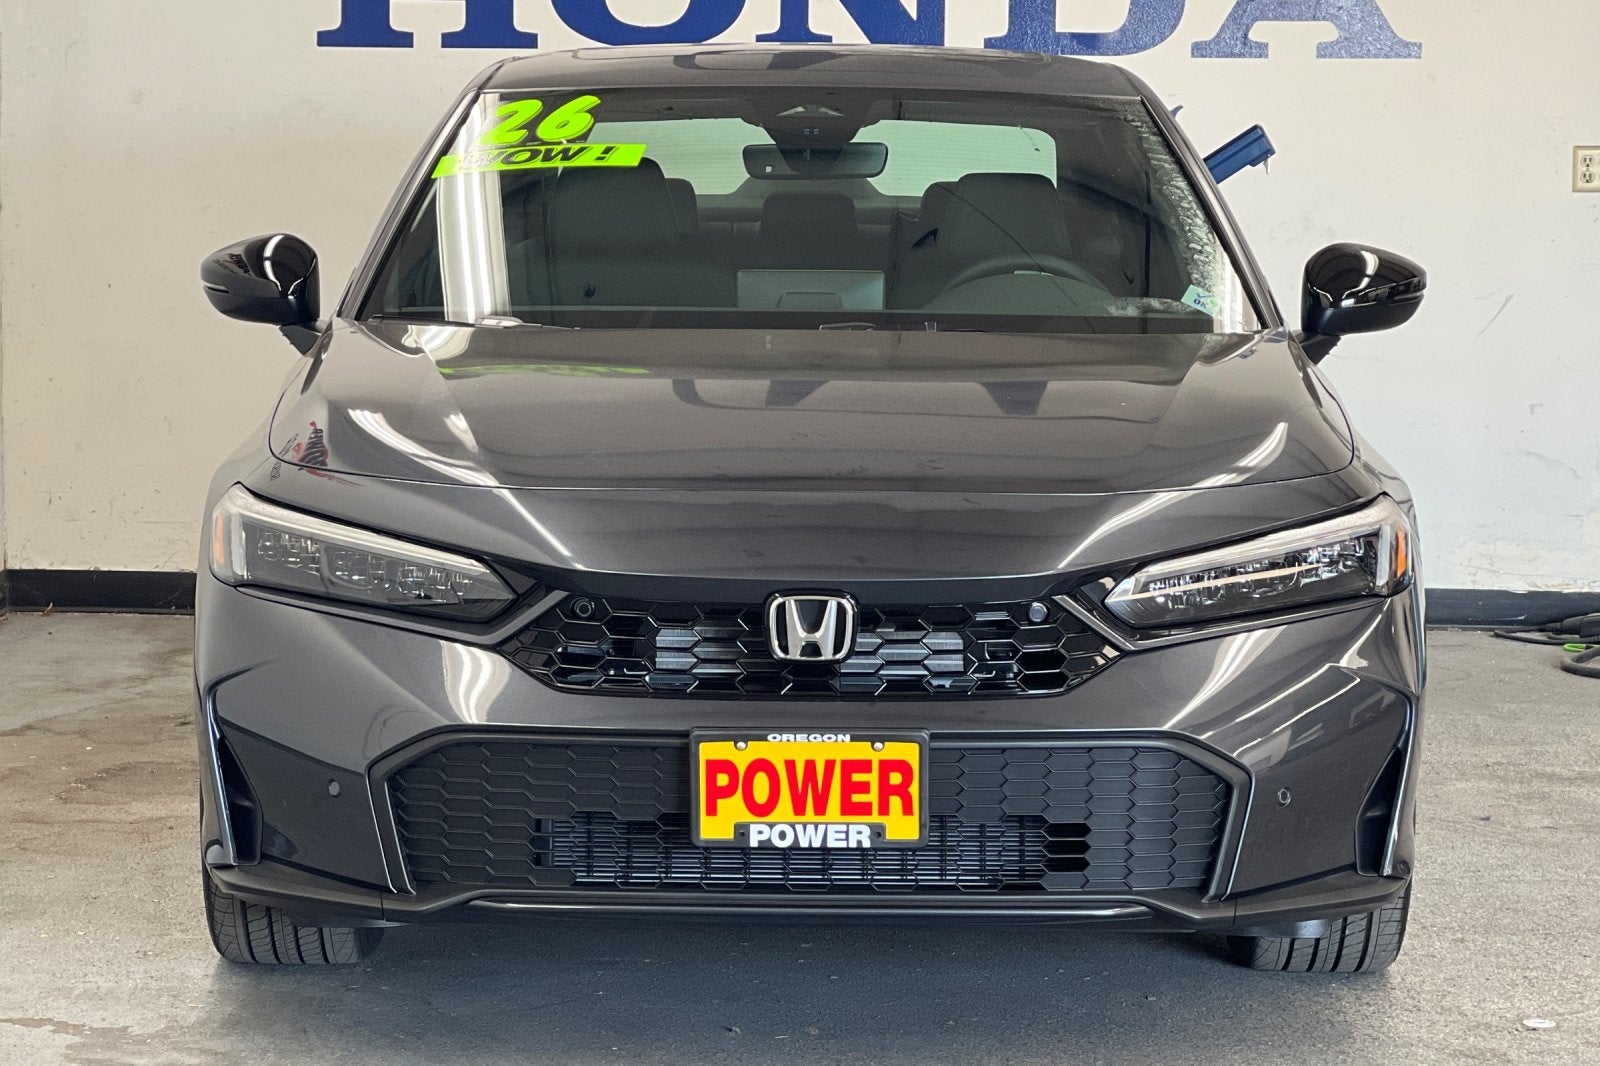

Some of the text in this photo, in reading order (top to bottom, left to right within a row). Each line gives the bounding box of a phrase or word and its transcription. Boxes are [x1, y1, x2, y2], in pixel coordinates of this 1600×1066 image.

[478, 95, 601, 144] 26
[767, 733, 850, 742] OREGON
[705, 758, 914, 817] POWER
[749, 824, 871, 848] POWER
